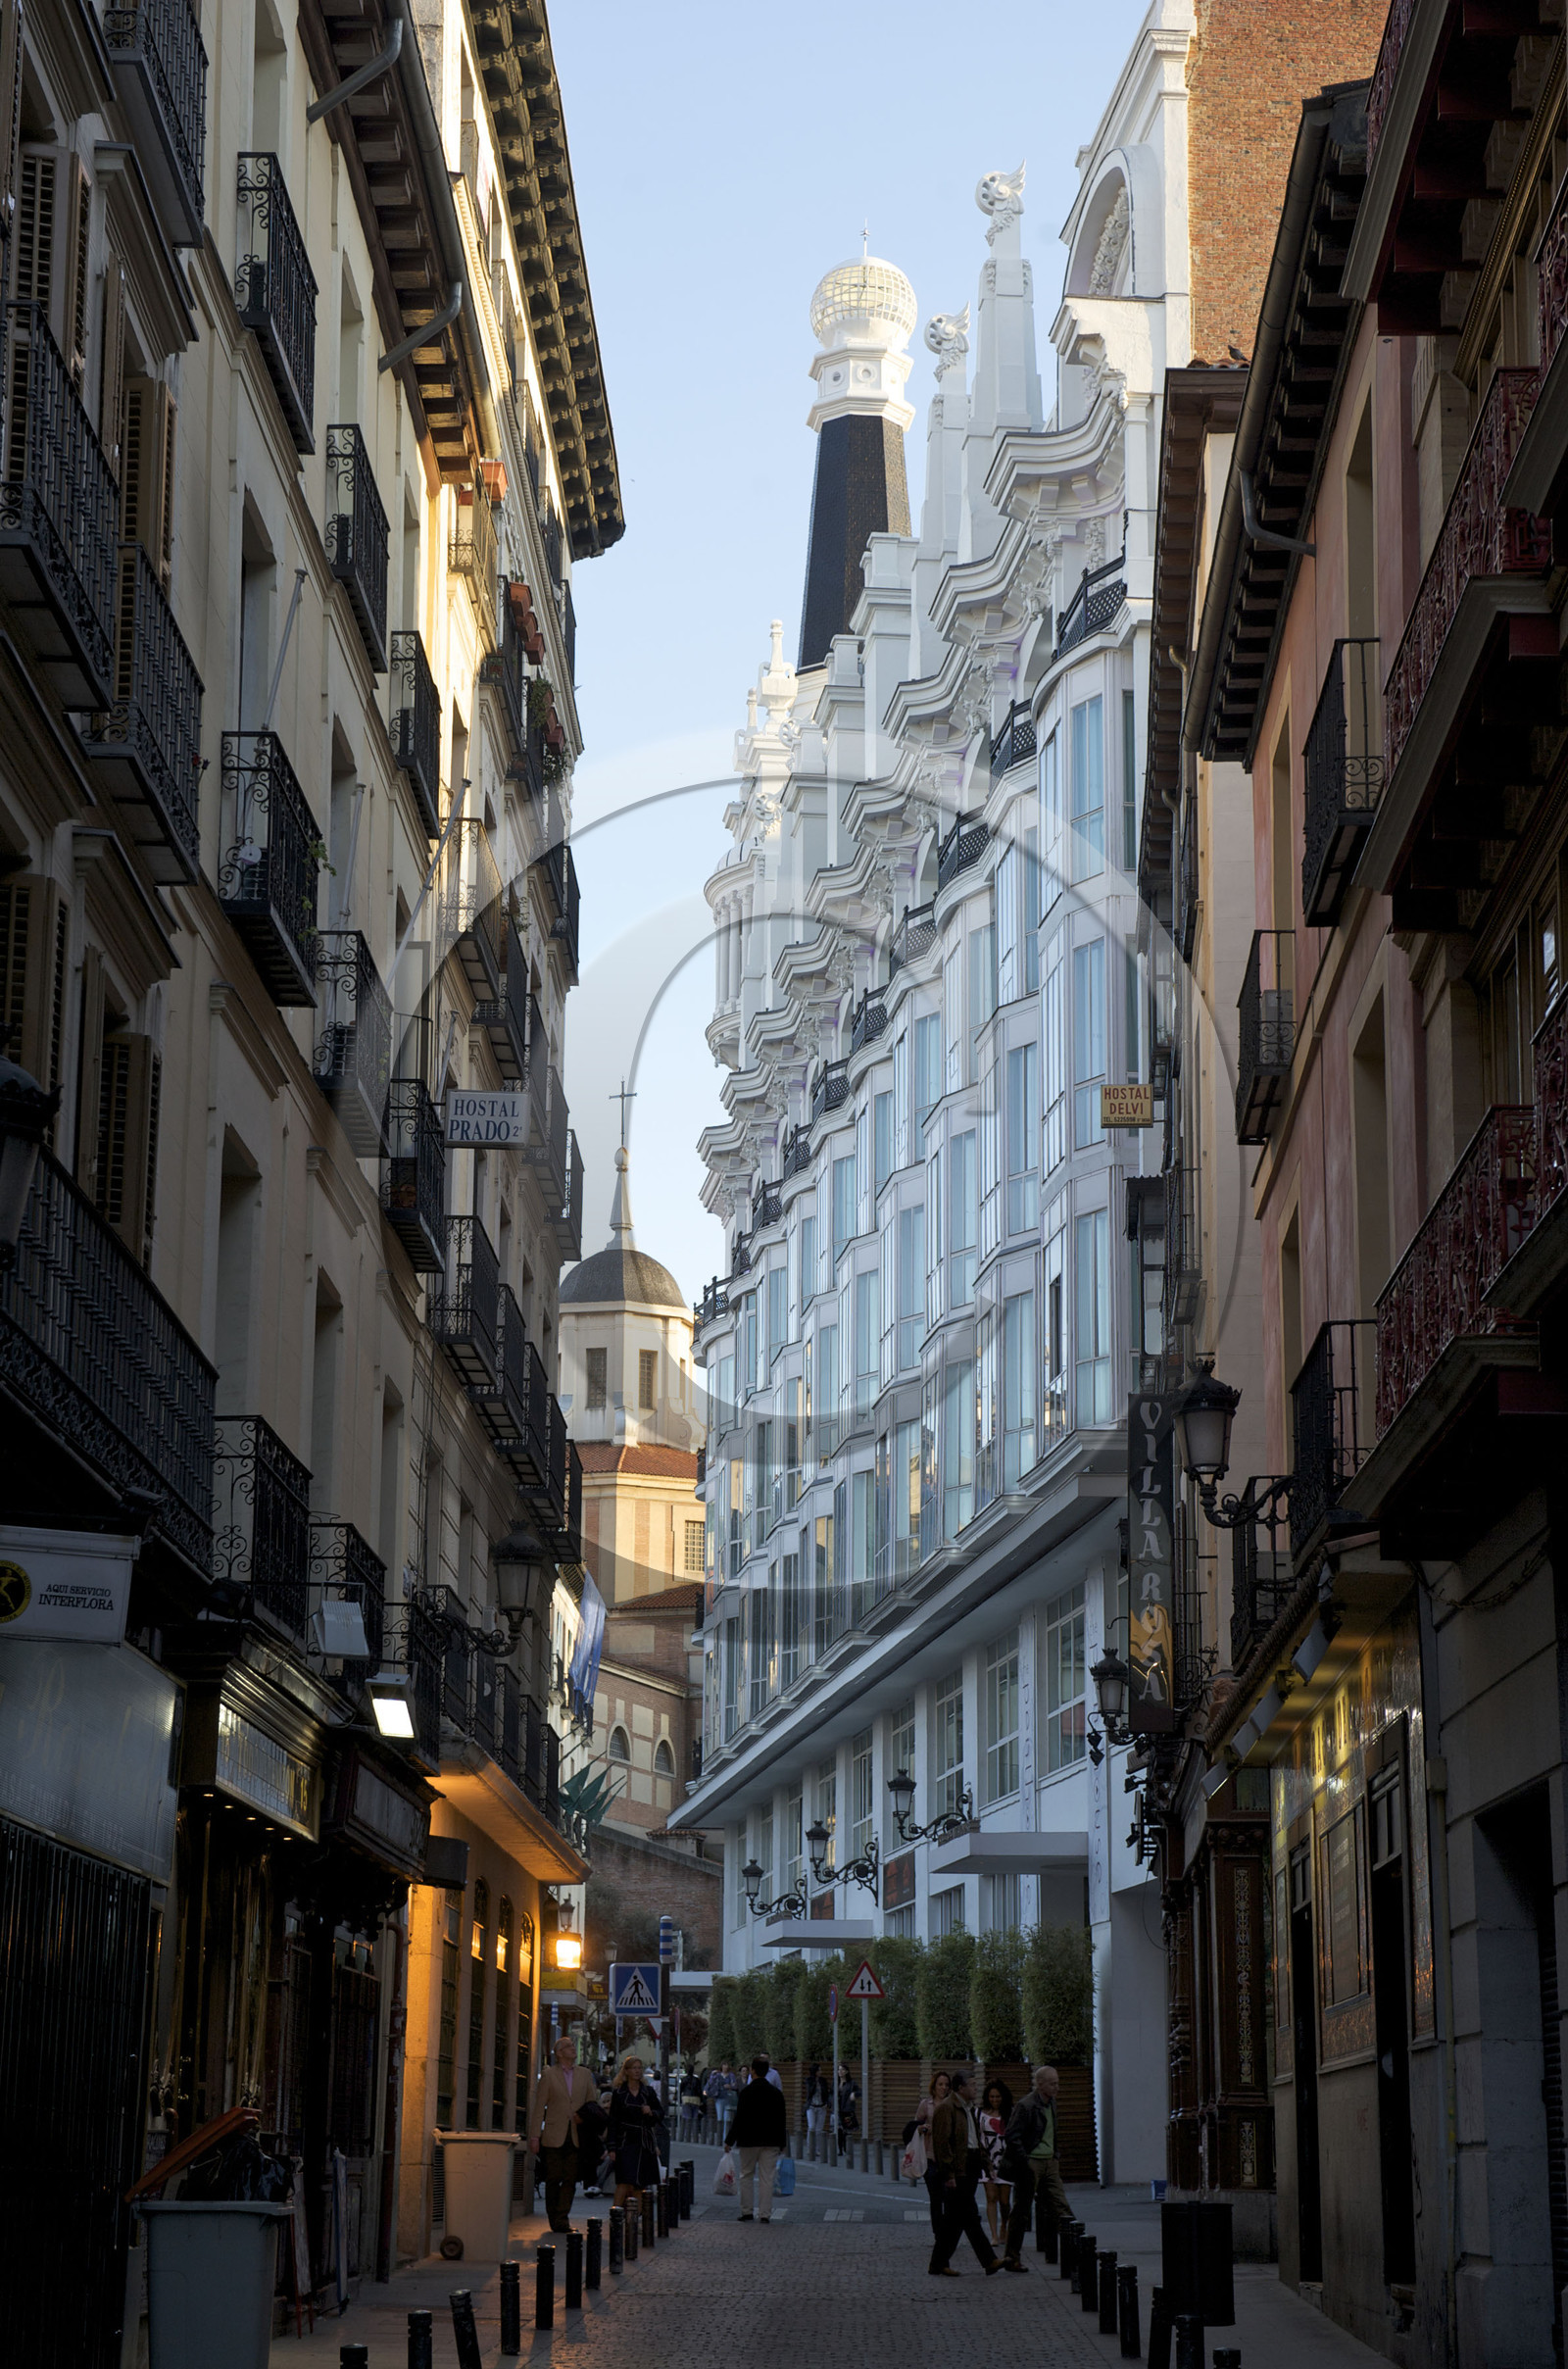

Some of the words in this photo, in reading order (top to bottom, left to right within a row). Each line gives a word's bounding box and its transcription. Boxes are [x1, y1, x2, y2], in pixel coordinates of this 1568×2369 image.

[1103, 1087, 1150, 1100] HOSTAL
[454, 1099, 519, 1117] HOSTAL
[1109, 1103, 1144, 1114] DELVI
[449, 1119, 511, 1141] PRADO
[1138, 1402, 1163, 1559] VILLA
[45, 1584, 69, 1594] AQUI
[71, 1585, 112, 1597] SERVICIO
[38, 1594, 114, 1610] INTERFLORA
[1138, 1572, 1165, 1702] ROSA
